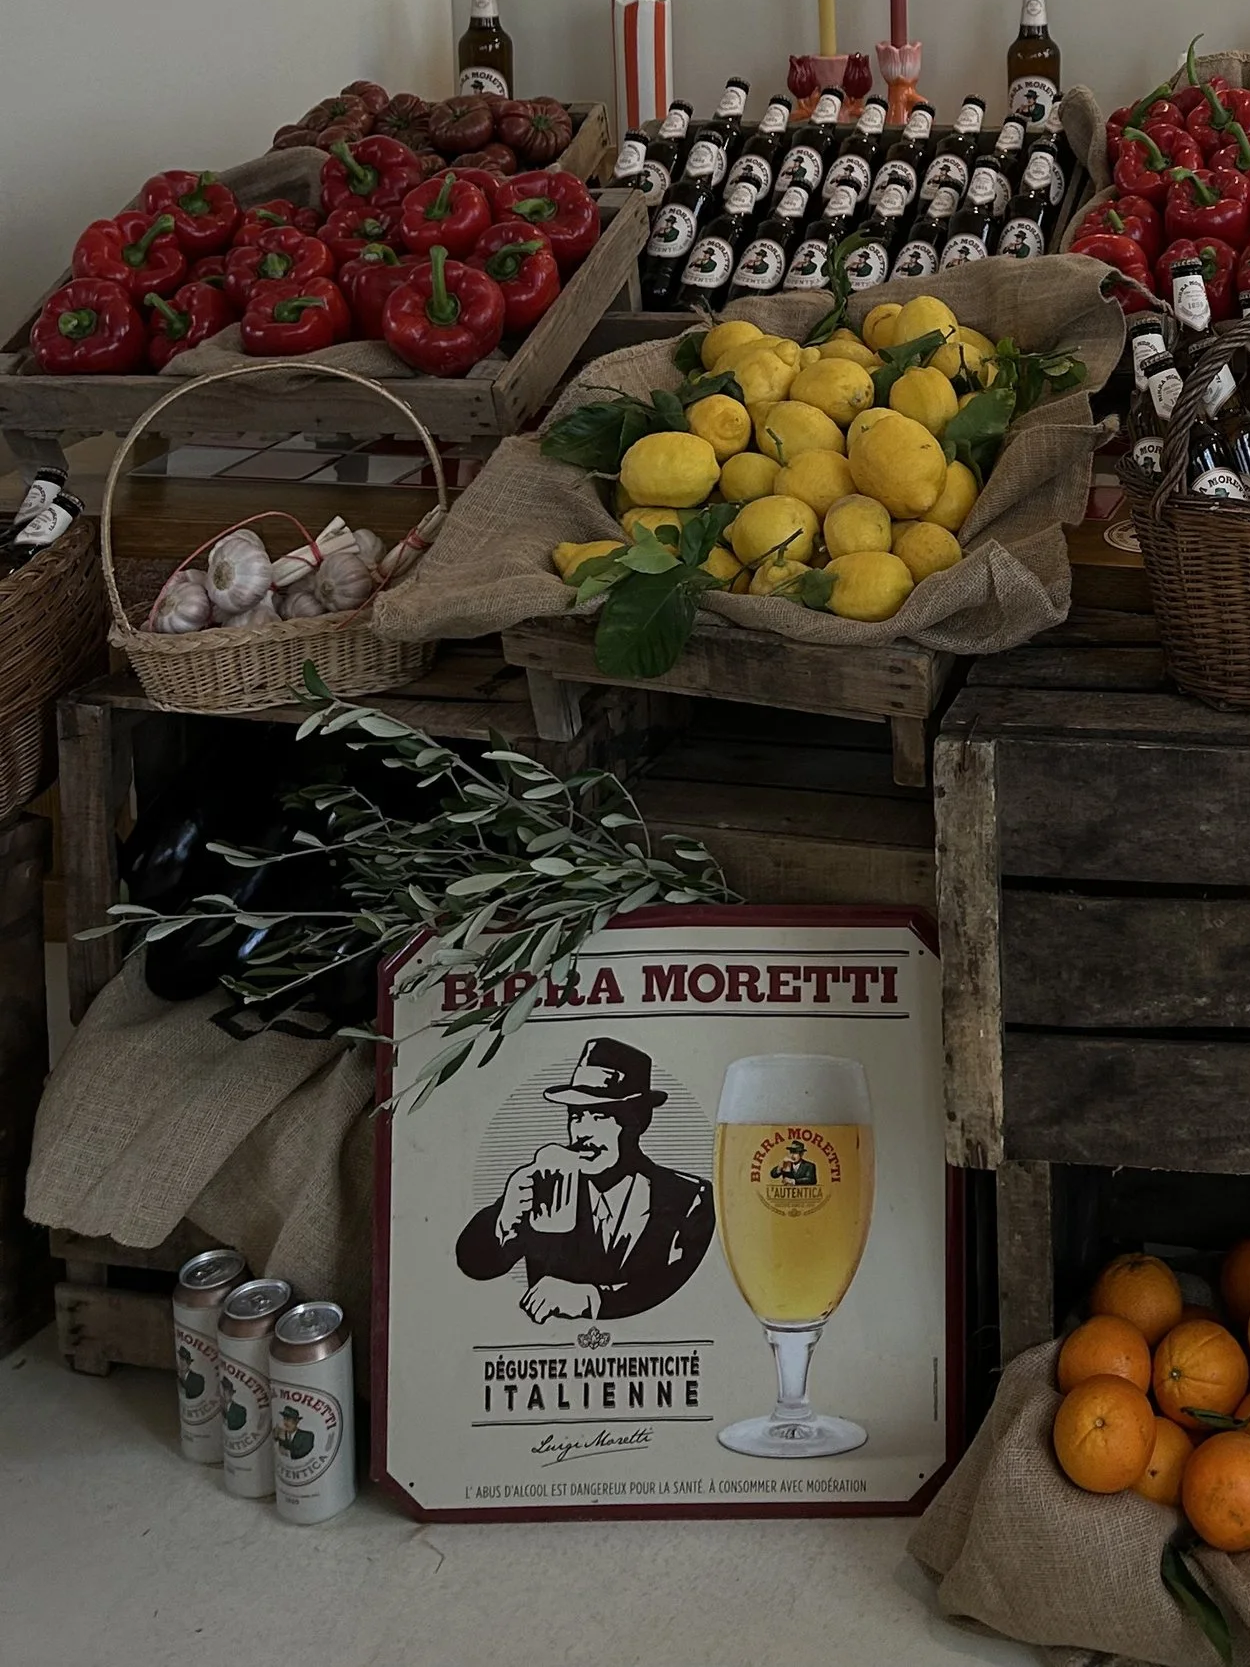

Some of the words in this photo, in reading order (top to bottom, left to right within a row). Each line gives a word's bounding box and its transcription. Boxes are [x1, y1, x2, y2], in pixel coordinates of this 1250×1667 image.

[642, 963, 899, 1004] MORETTI
[751, 1132, 785, 1183] BIRRA
[787, 1127, 841, 1183] MORETTI
[766, 1187, 823, 1199] L'AUTENTICA
[484, 1355, 568, 1381] DÉGUSTEZ
[574, 1350, 700, 1378] L'AUTHENTICITÉ
[280, 1389, 337, 1431] MORETTI
[485, 1380, 699, 1412] ITALIENNE
[531, 1434, 583, 1462] Luigi
[584, 1428, 653, 1448] Moretti
[476, 1485, 501, 1499] ABUS
[504, 1484, 548, 1498] D'ALCOOL
[551, 1483, 568, 1497] EST
[570, 1482, 627, 1496] DANGEREUX
[630, 1481, 656, 1495] POUR
[658, 1482, 670, 1494] LA
[719, 1480, 777, 1494] CONSOMMER
[780, 1479, 804, 1493] AVEC
[806, 1477, 867, 1493] MODÉRATION
